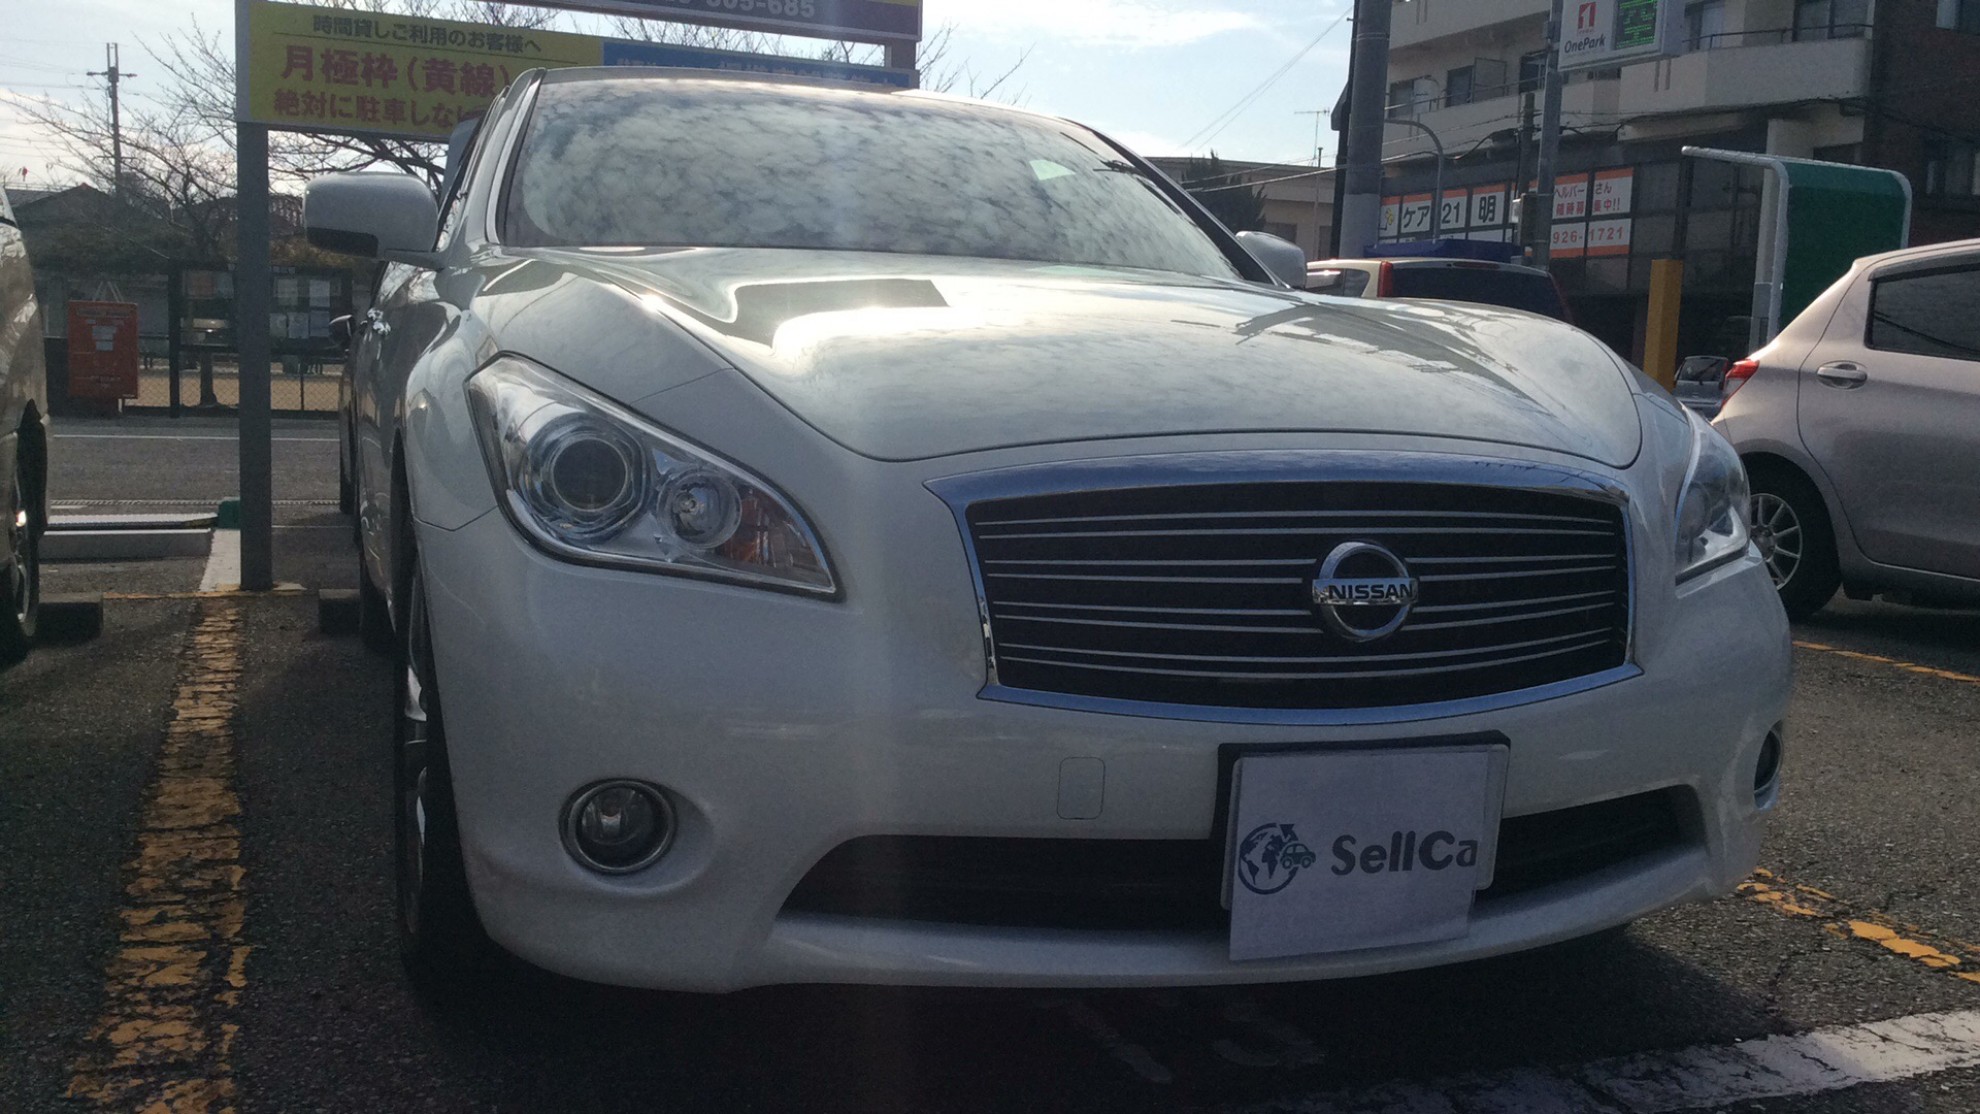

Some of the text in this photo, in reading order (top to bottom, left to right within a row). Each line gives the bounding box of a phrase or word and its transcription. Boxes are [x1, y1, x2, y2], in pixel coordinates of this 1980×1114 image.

[1564, 34, 1605, 53] OnePark
[1328, 583, 1413, 600] NISSAN
[1331, 830, 1478, 876] SellCa
